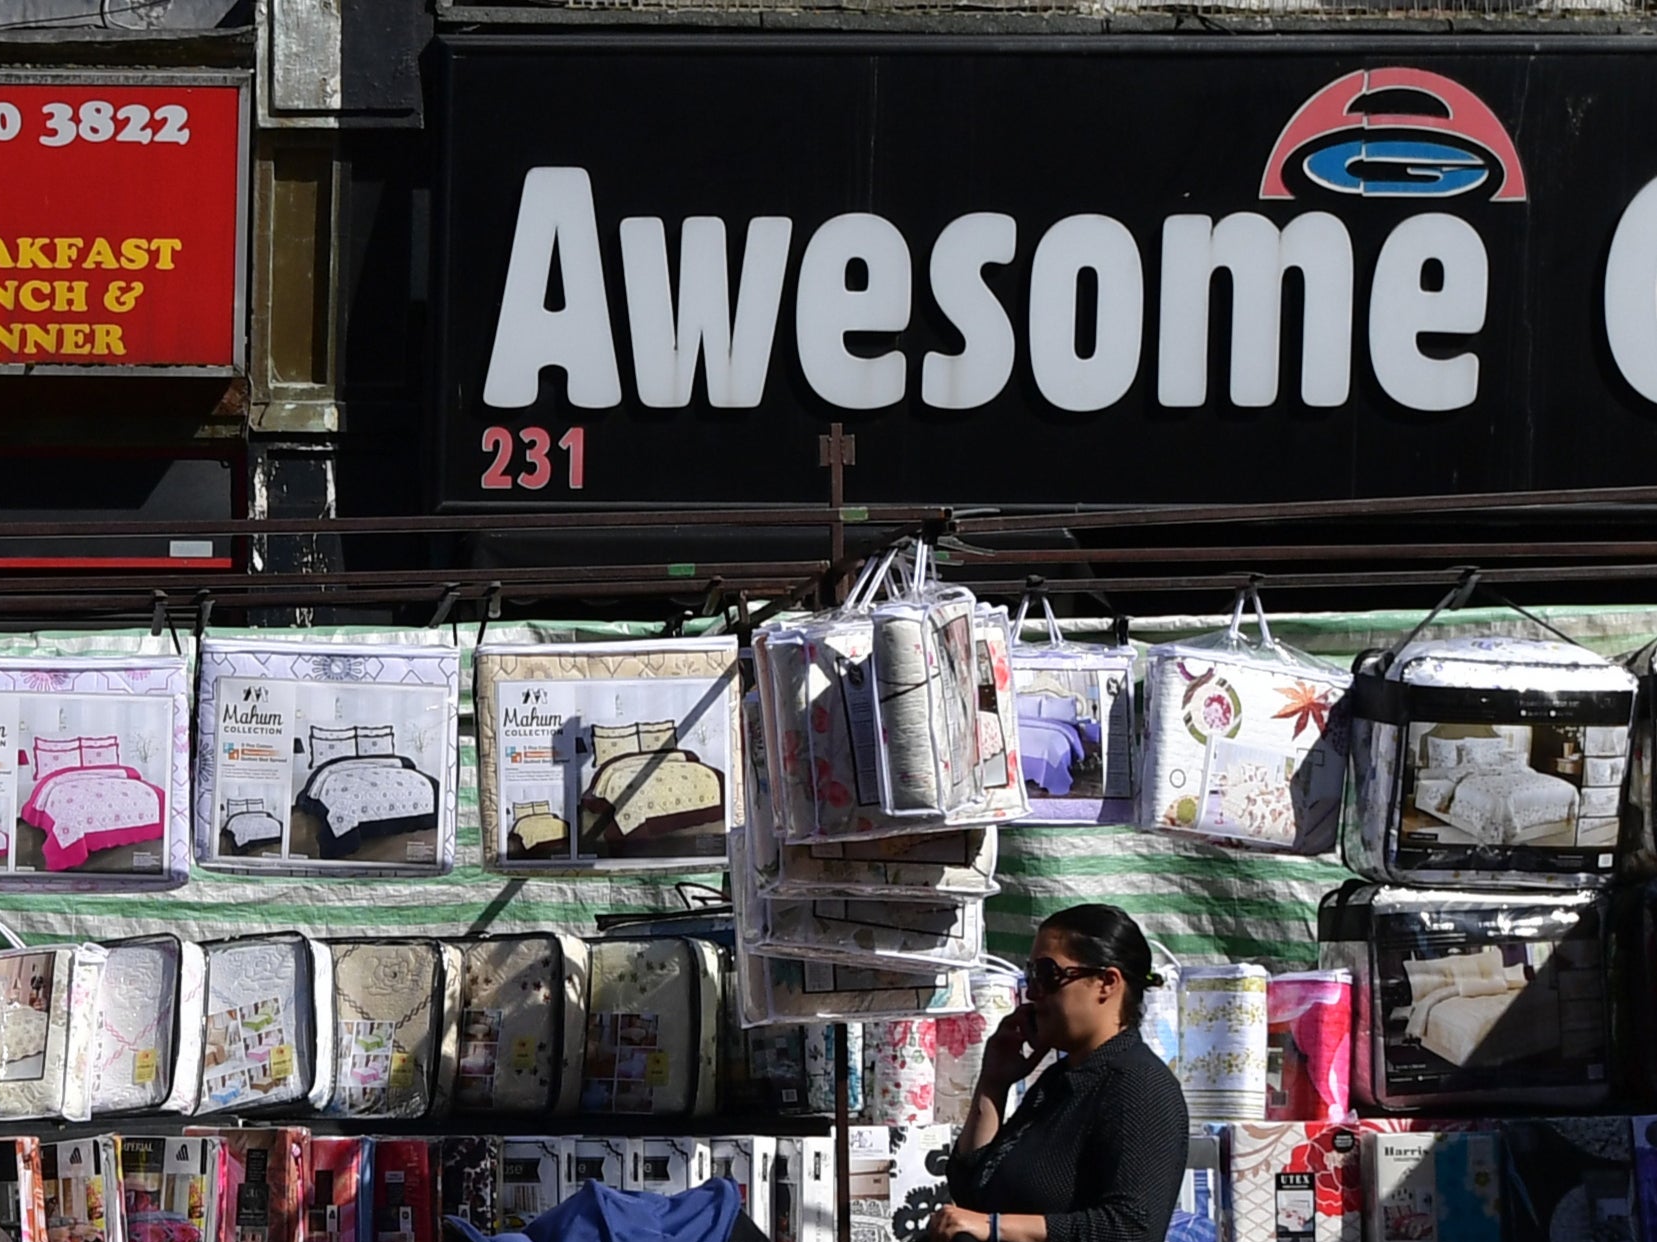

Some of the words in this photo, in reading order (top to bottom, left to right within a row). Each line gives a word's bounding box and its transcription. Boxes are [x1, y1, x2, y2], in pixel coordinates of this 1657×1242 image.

[39, 97, 191, 147] 3822
[99, 279, 144, 314] &
[482, 165, 1491, 412] Awesome
[480, 426, 586, 490] 231
[223, 703, 284, 726] Mahum
[503, 706, 563, 727] Mahum
[223, 726, 283, 735] COLLECTION
[504, 728, 564, 737] COLLECTION
[1385, 1146, 1429, 1157] Harris
[1280, 1174, 1311, 1185] UTEX
